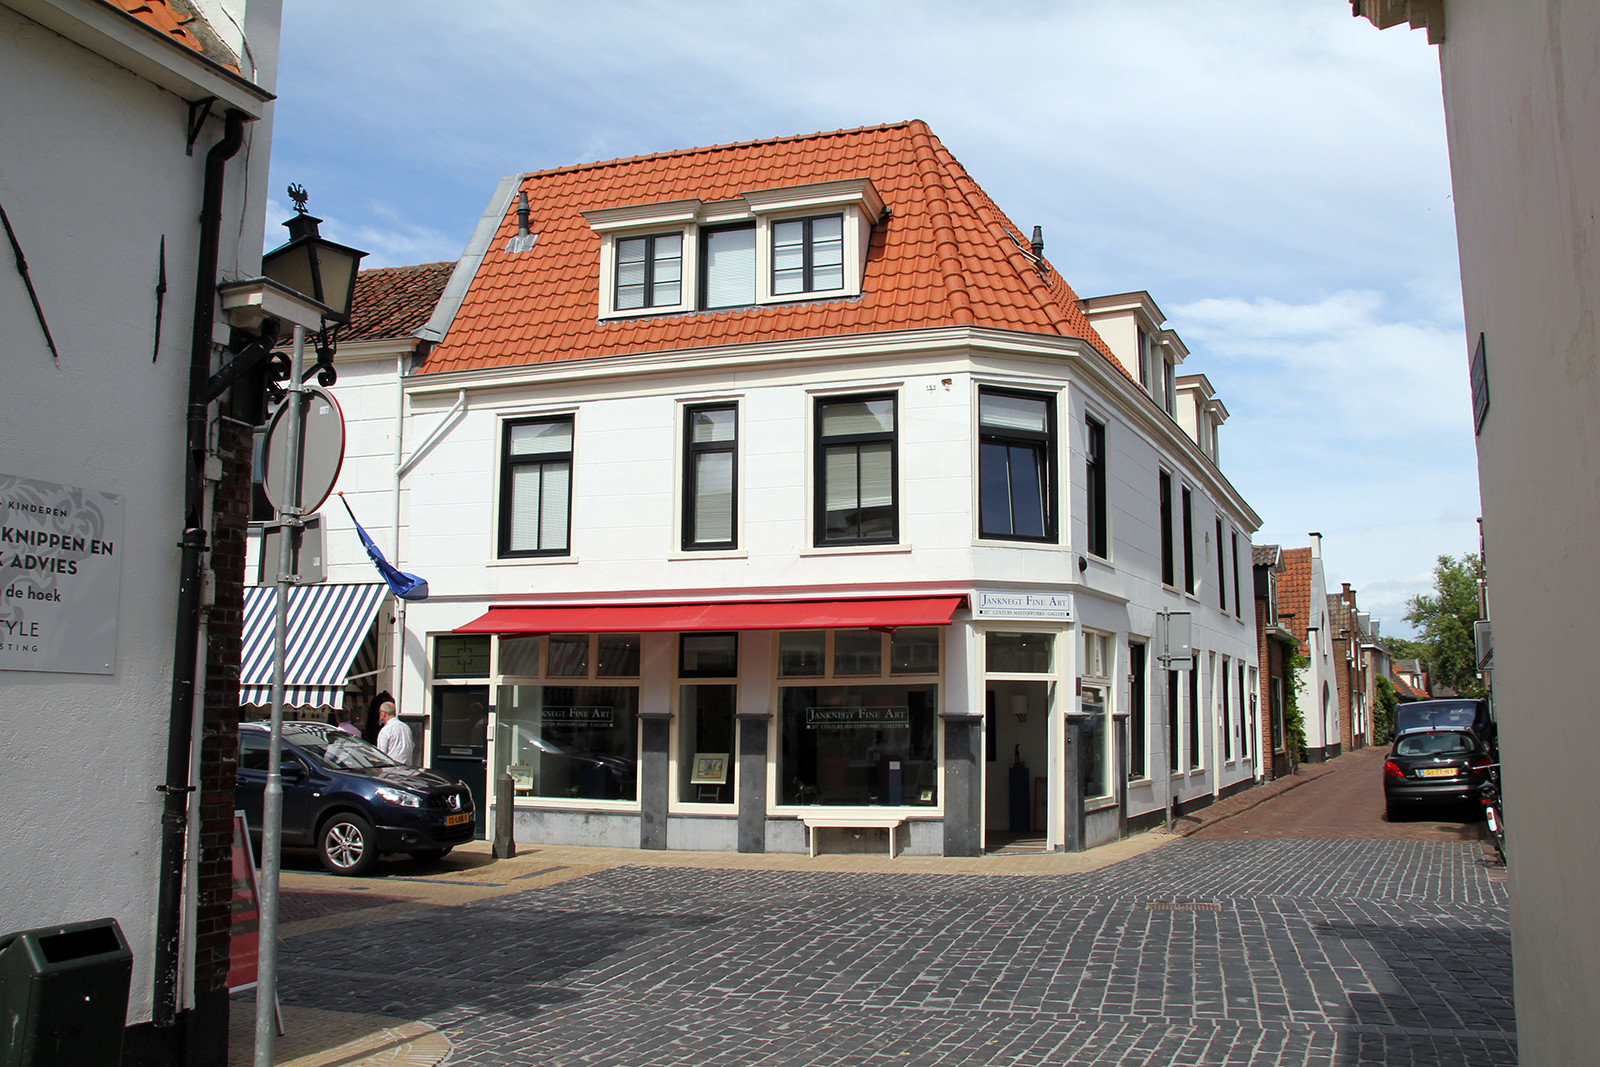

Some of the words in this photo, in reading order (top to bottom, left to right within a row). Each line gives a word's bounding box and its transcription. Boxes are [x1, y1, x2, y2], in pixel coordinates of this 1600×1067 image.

[8, 501, 68, 518] KINDEREN
[1, 526, 85, 552] KNIPPEN
[90, 539, 114, 556] EN
[10, 554, 78, 575] ADVIES
[5, 584, 24, 599] de
[27, 586, 62, 602] hoek
[981, 594, 1023, 607] JANKNEGT
[1026, 595, 1045, 606] FINE
[1049, 597, 1067, 607] ART
[569, 707, 589, 718] FINE
[591, 708, 610, 718] ART
[808, 709, 855, 722] JANKNEGT
[858, 708, 880, 719] FINE
[884, 708, 906, 719] ART
